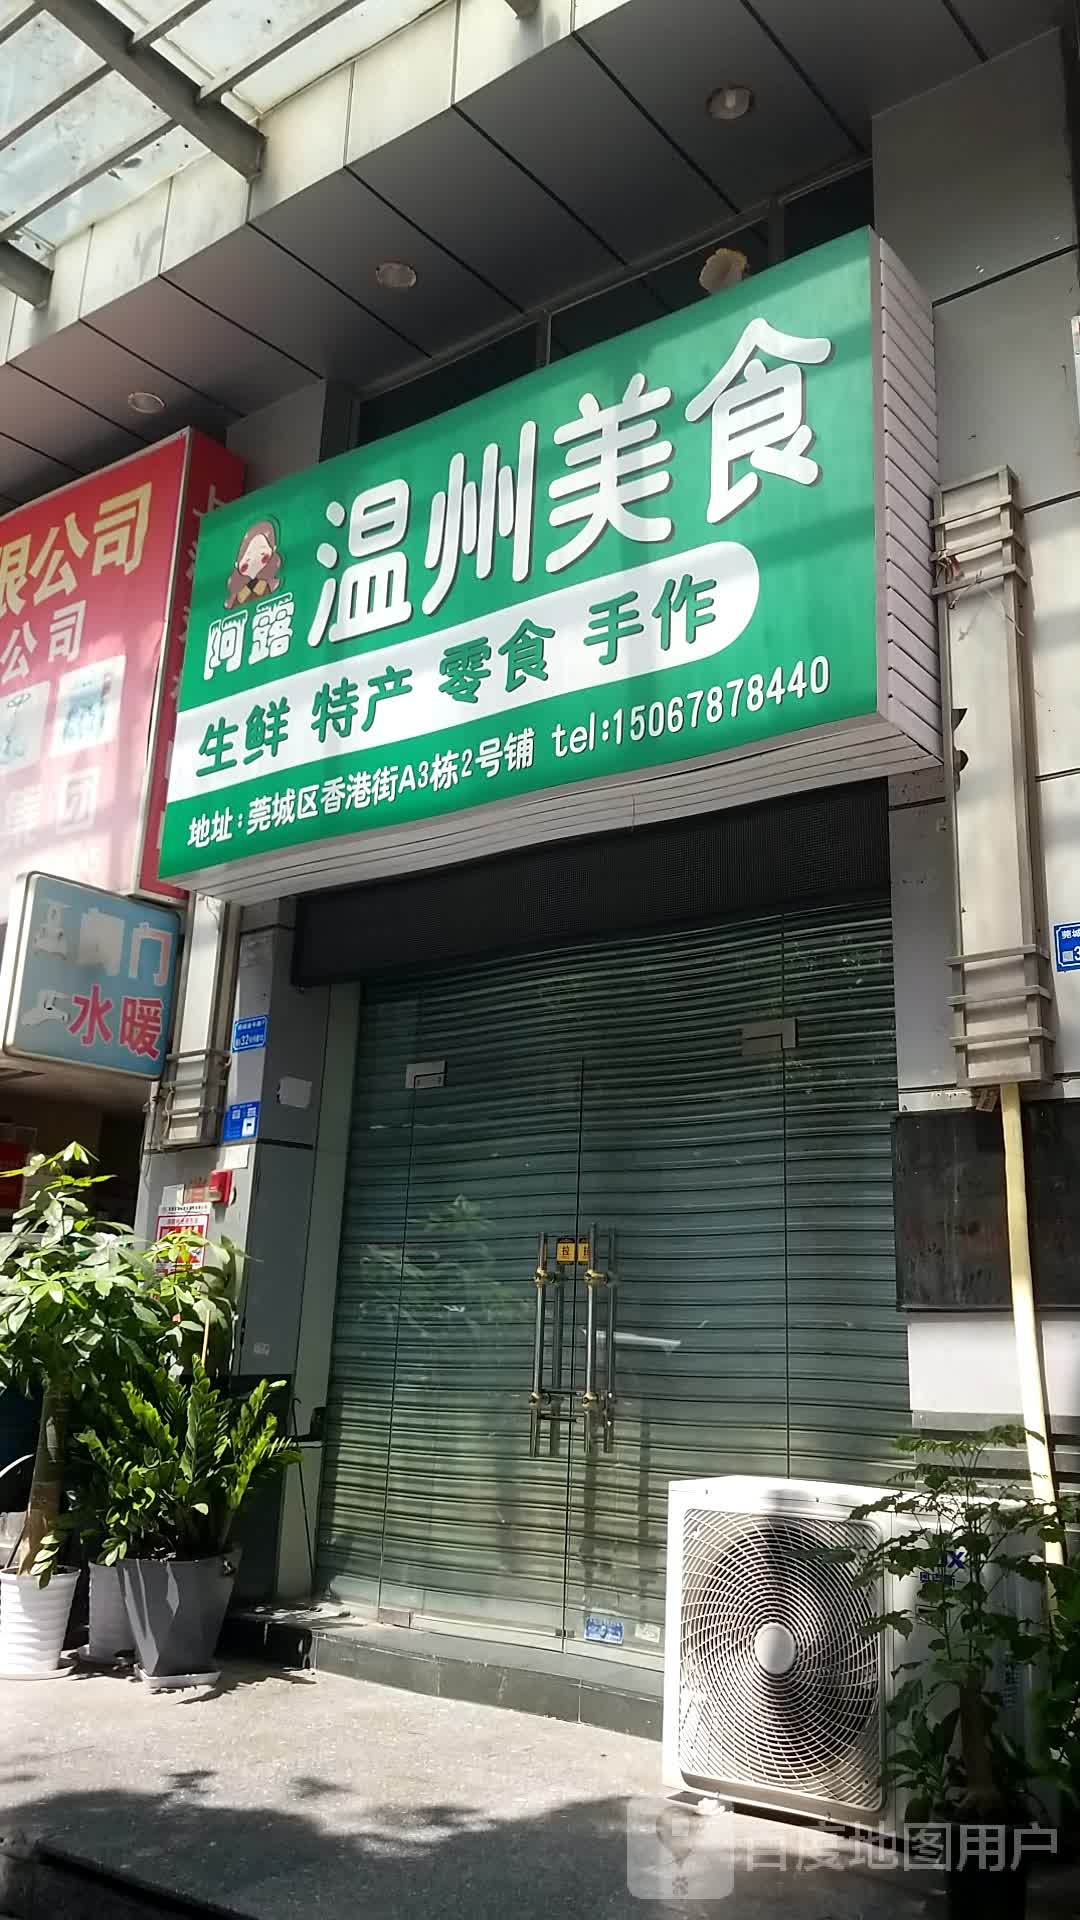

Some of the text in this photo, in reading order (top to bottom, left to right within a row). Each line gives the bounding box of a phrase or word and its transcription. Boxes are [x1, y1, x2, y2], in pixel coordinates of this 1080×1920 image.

[308, 317, 832, 648] 温州美食
[0, 600, 86, 684] 公司
[196, 573, 718, 777] 生鲜 特产 零食 手作
[203, 592, 294, 681] 阿露
[551, 655, 830, 758] tel:15067878440
[68, 983, 162, 1061] 水暖
